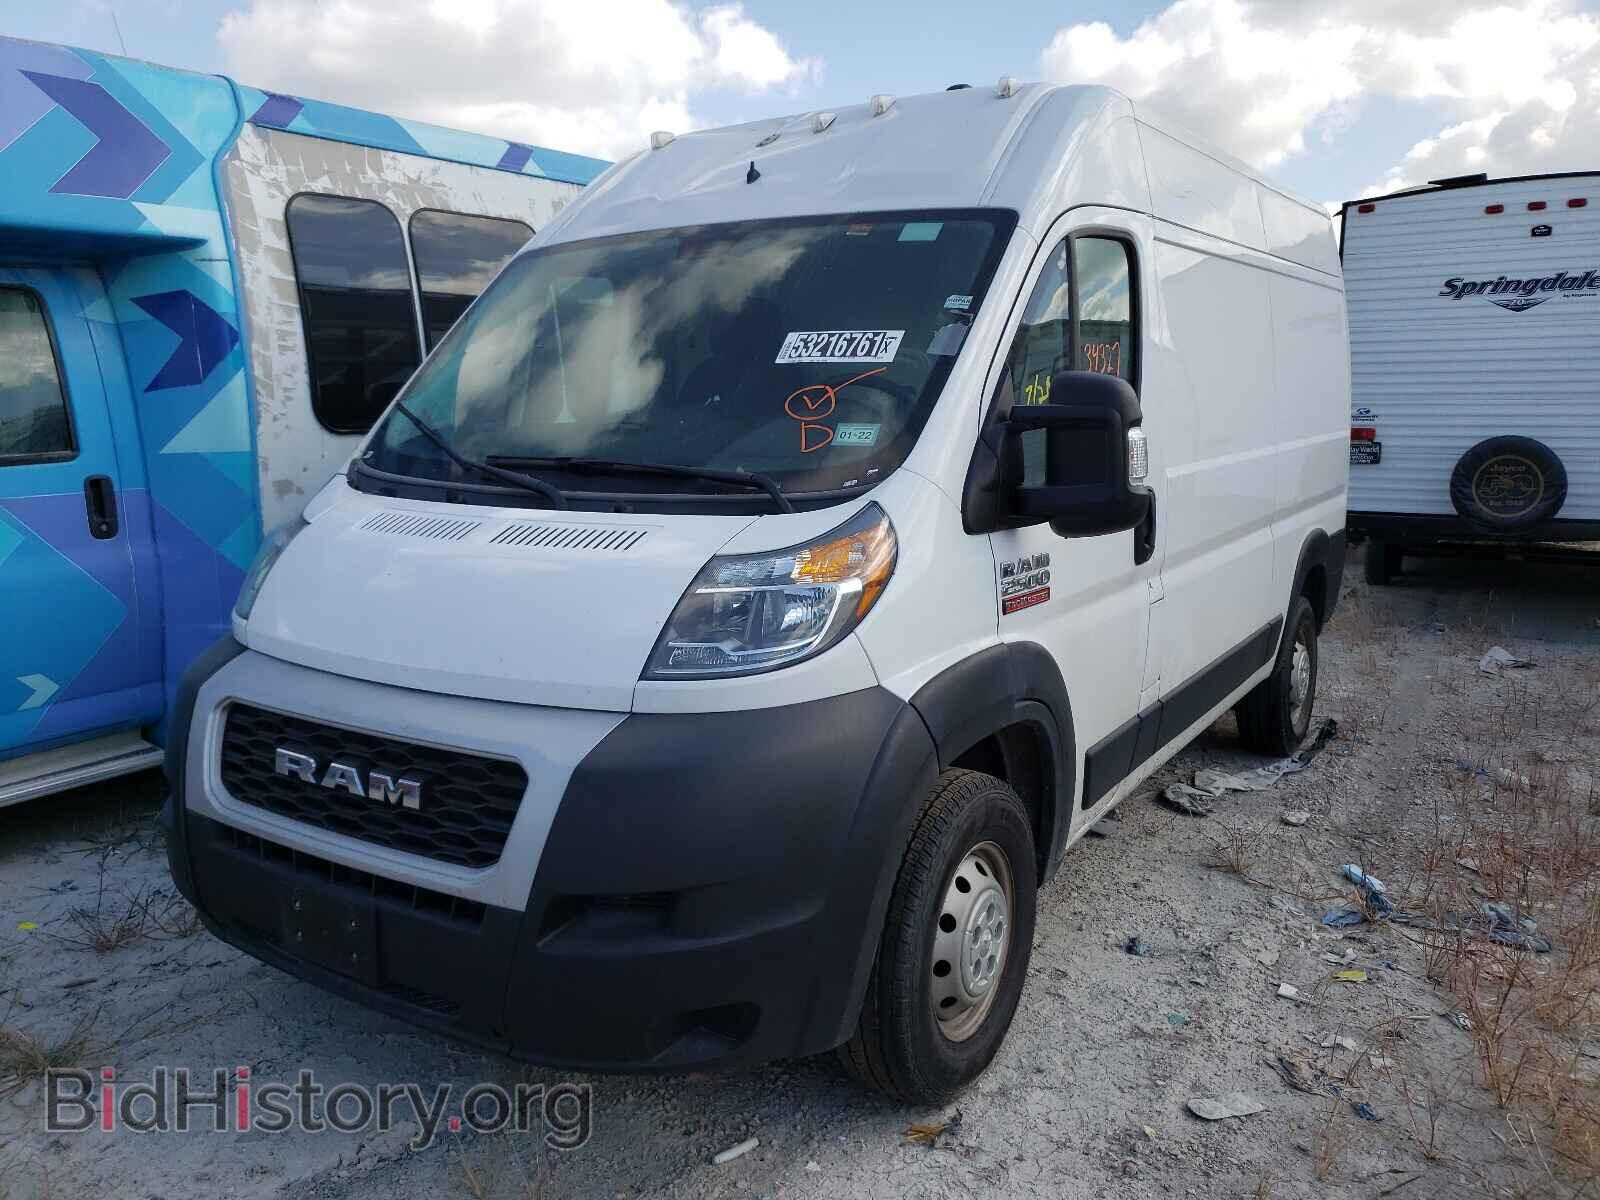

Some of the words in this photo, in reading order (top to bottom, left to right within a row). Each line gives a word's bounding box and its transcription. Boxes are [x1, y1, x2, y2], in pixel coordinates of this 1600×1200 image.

[788, 332, 887, 358] 53216761
[1000, 552, 1050, 580] RAM
[274, 747, 422, 811] RAM
